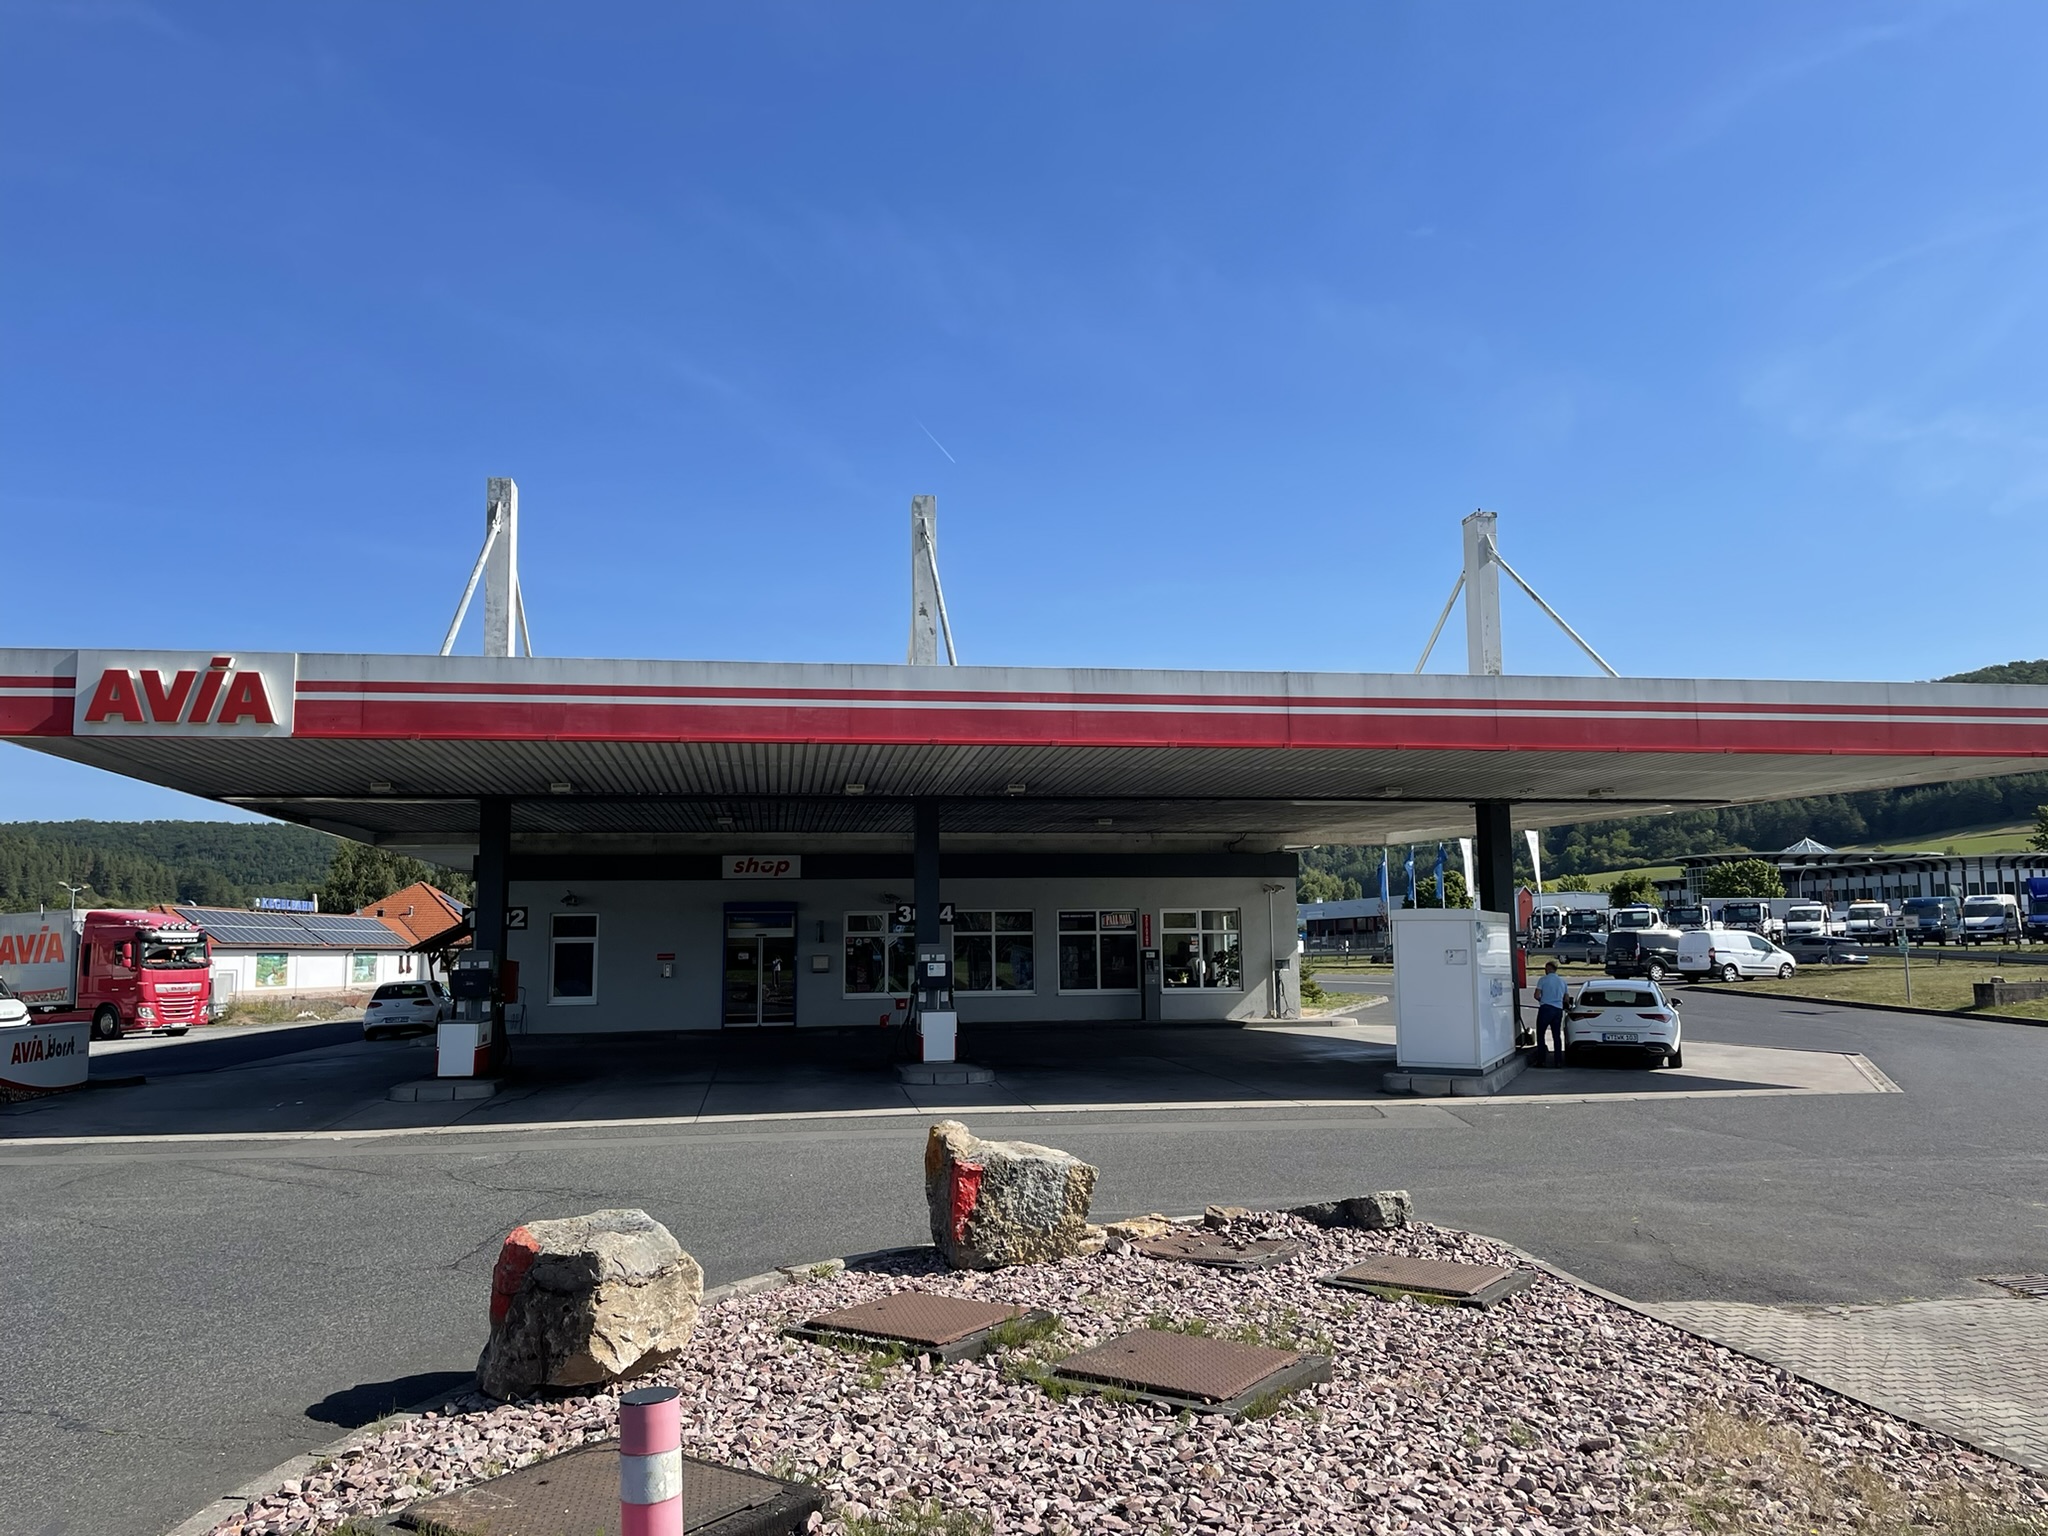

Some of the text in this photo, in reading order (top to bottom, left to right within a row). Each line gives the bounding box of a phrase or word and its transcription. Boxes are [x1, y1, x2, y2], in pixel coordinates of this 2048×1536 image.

[734, 857, 790, 876] shop
[464, 911, 476, 929] 1
[510, 909, 525, 927] 2
[898, 905, 912, 923] 3
[939, 905, 954, 922] 4
